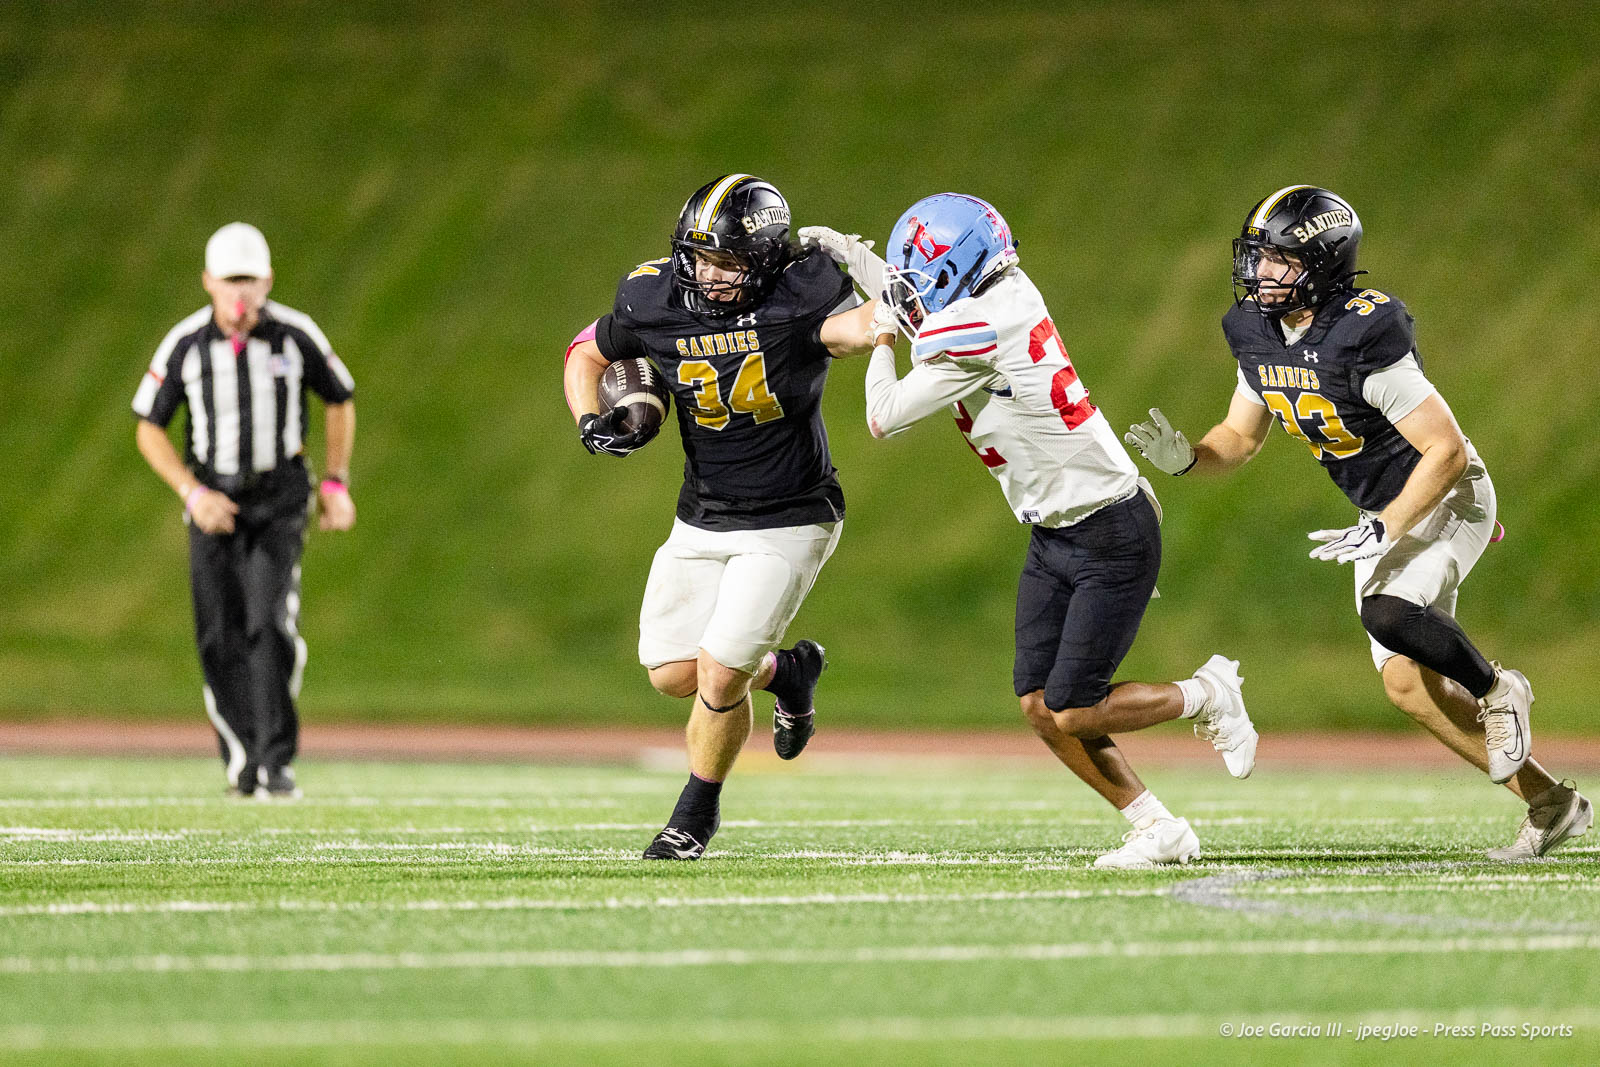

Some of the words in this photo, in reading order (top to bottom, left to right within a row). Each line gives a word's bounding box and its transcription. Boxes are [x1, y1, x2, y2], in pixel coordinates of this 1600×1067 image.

[741, 207, 790, 234] SANDIES
[1293, 209, 1351, 244] SANDIES
[1345, 288, 1390, 316] 33
[676, 330, 760, 357] SANDIES
[1258, 365, 1320, 389] SANDIES
[677, 352, 785, 431] 34
[1262, 391, 1365, 461] 33
